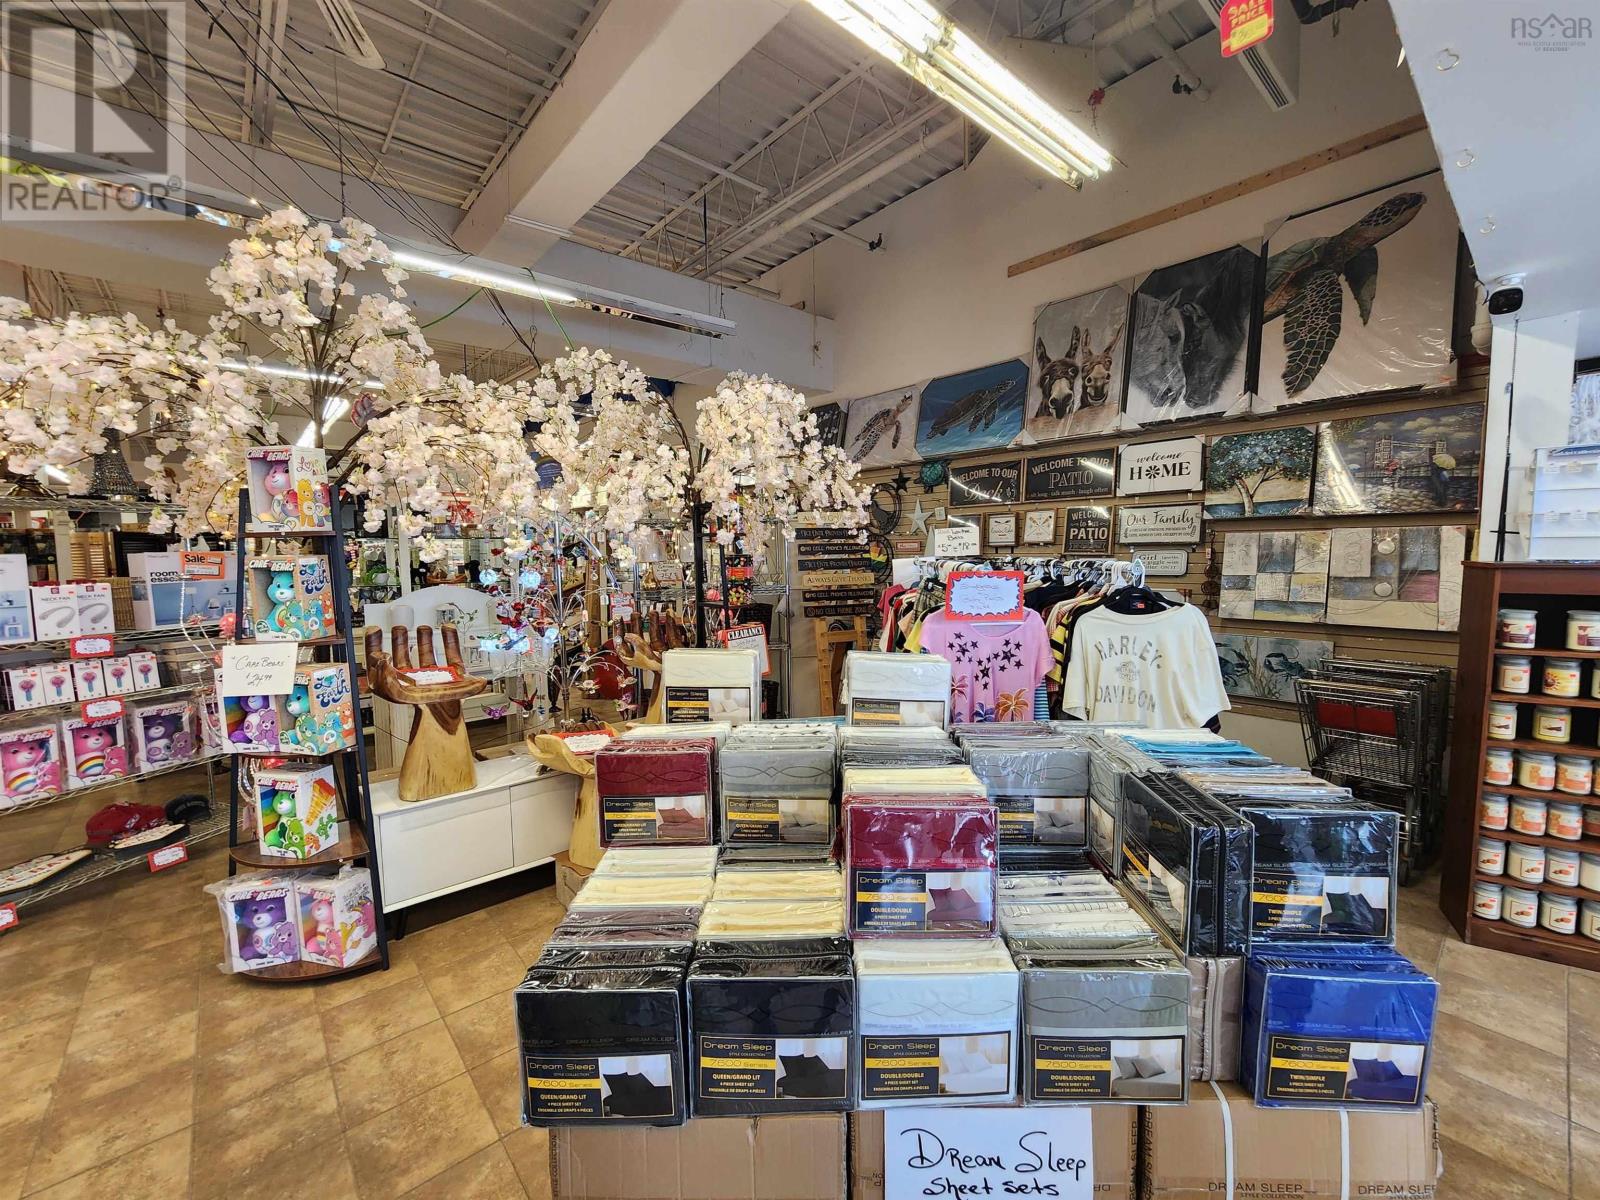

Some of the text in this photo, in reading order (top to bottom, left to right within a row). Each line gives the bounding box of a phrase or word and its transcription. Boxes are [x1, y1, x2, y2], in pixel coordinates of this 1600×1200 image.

[1231, 5, 1265, 28] PRICE
[1137, 452, 1182, 463] welcome
[1032, 458, 1074, 475] WELCOME
[956, 468, 1018, 482] WELCOME TO OUR
[1048, 470, 1093, 489] PATIO
[1127, 509, 1194, 529] Our Family
[1070, 528, 1108, 540] PATIO
[185, 554, 206, 563] Sale
[271, 562, 296, 572] BEARS
[728, 626, 763, 640] CLEARANCE
[274, 781, 300, 792] BEARS
[895, 877, 923, 887] Sleep
[1253, 877, 1288, 885] Dream
[229, 888, 289, 901] CARE BEARS
[703, 1042, 773, 1051] Dream Sleep
[868, 1042, 936, 1050] Dream Sleep
[1275, 1043, 1347, 1054] Dream Sleep
[529, 1062, 596, 1071] Dream Sleep
[709, 1059, 742, 1067] 7600
[1014, 1131, 1087, 1181] Sleep
[922, 1177, 1060, 1200] Sheet sets
[1208, 1182, 1303, 1193] DRAM SLEEP
[1358, 1185, 1403, 1194] DREAM
